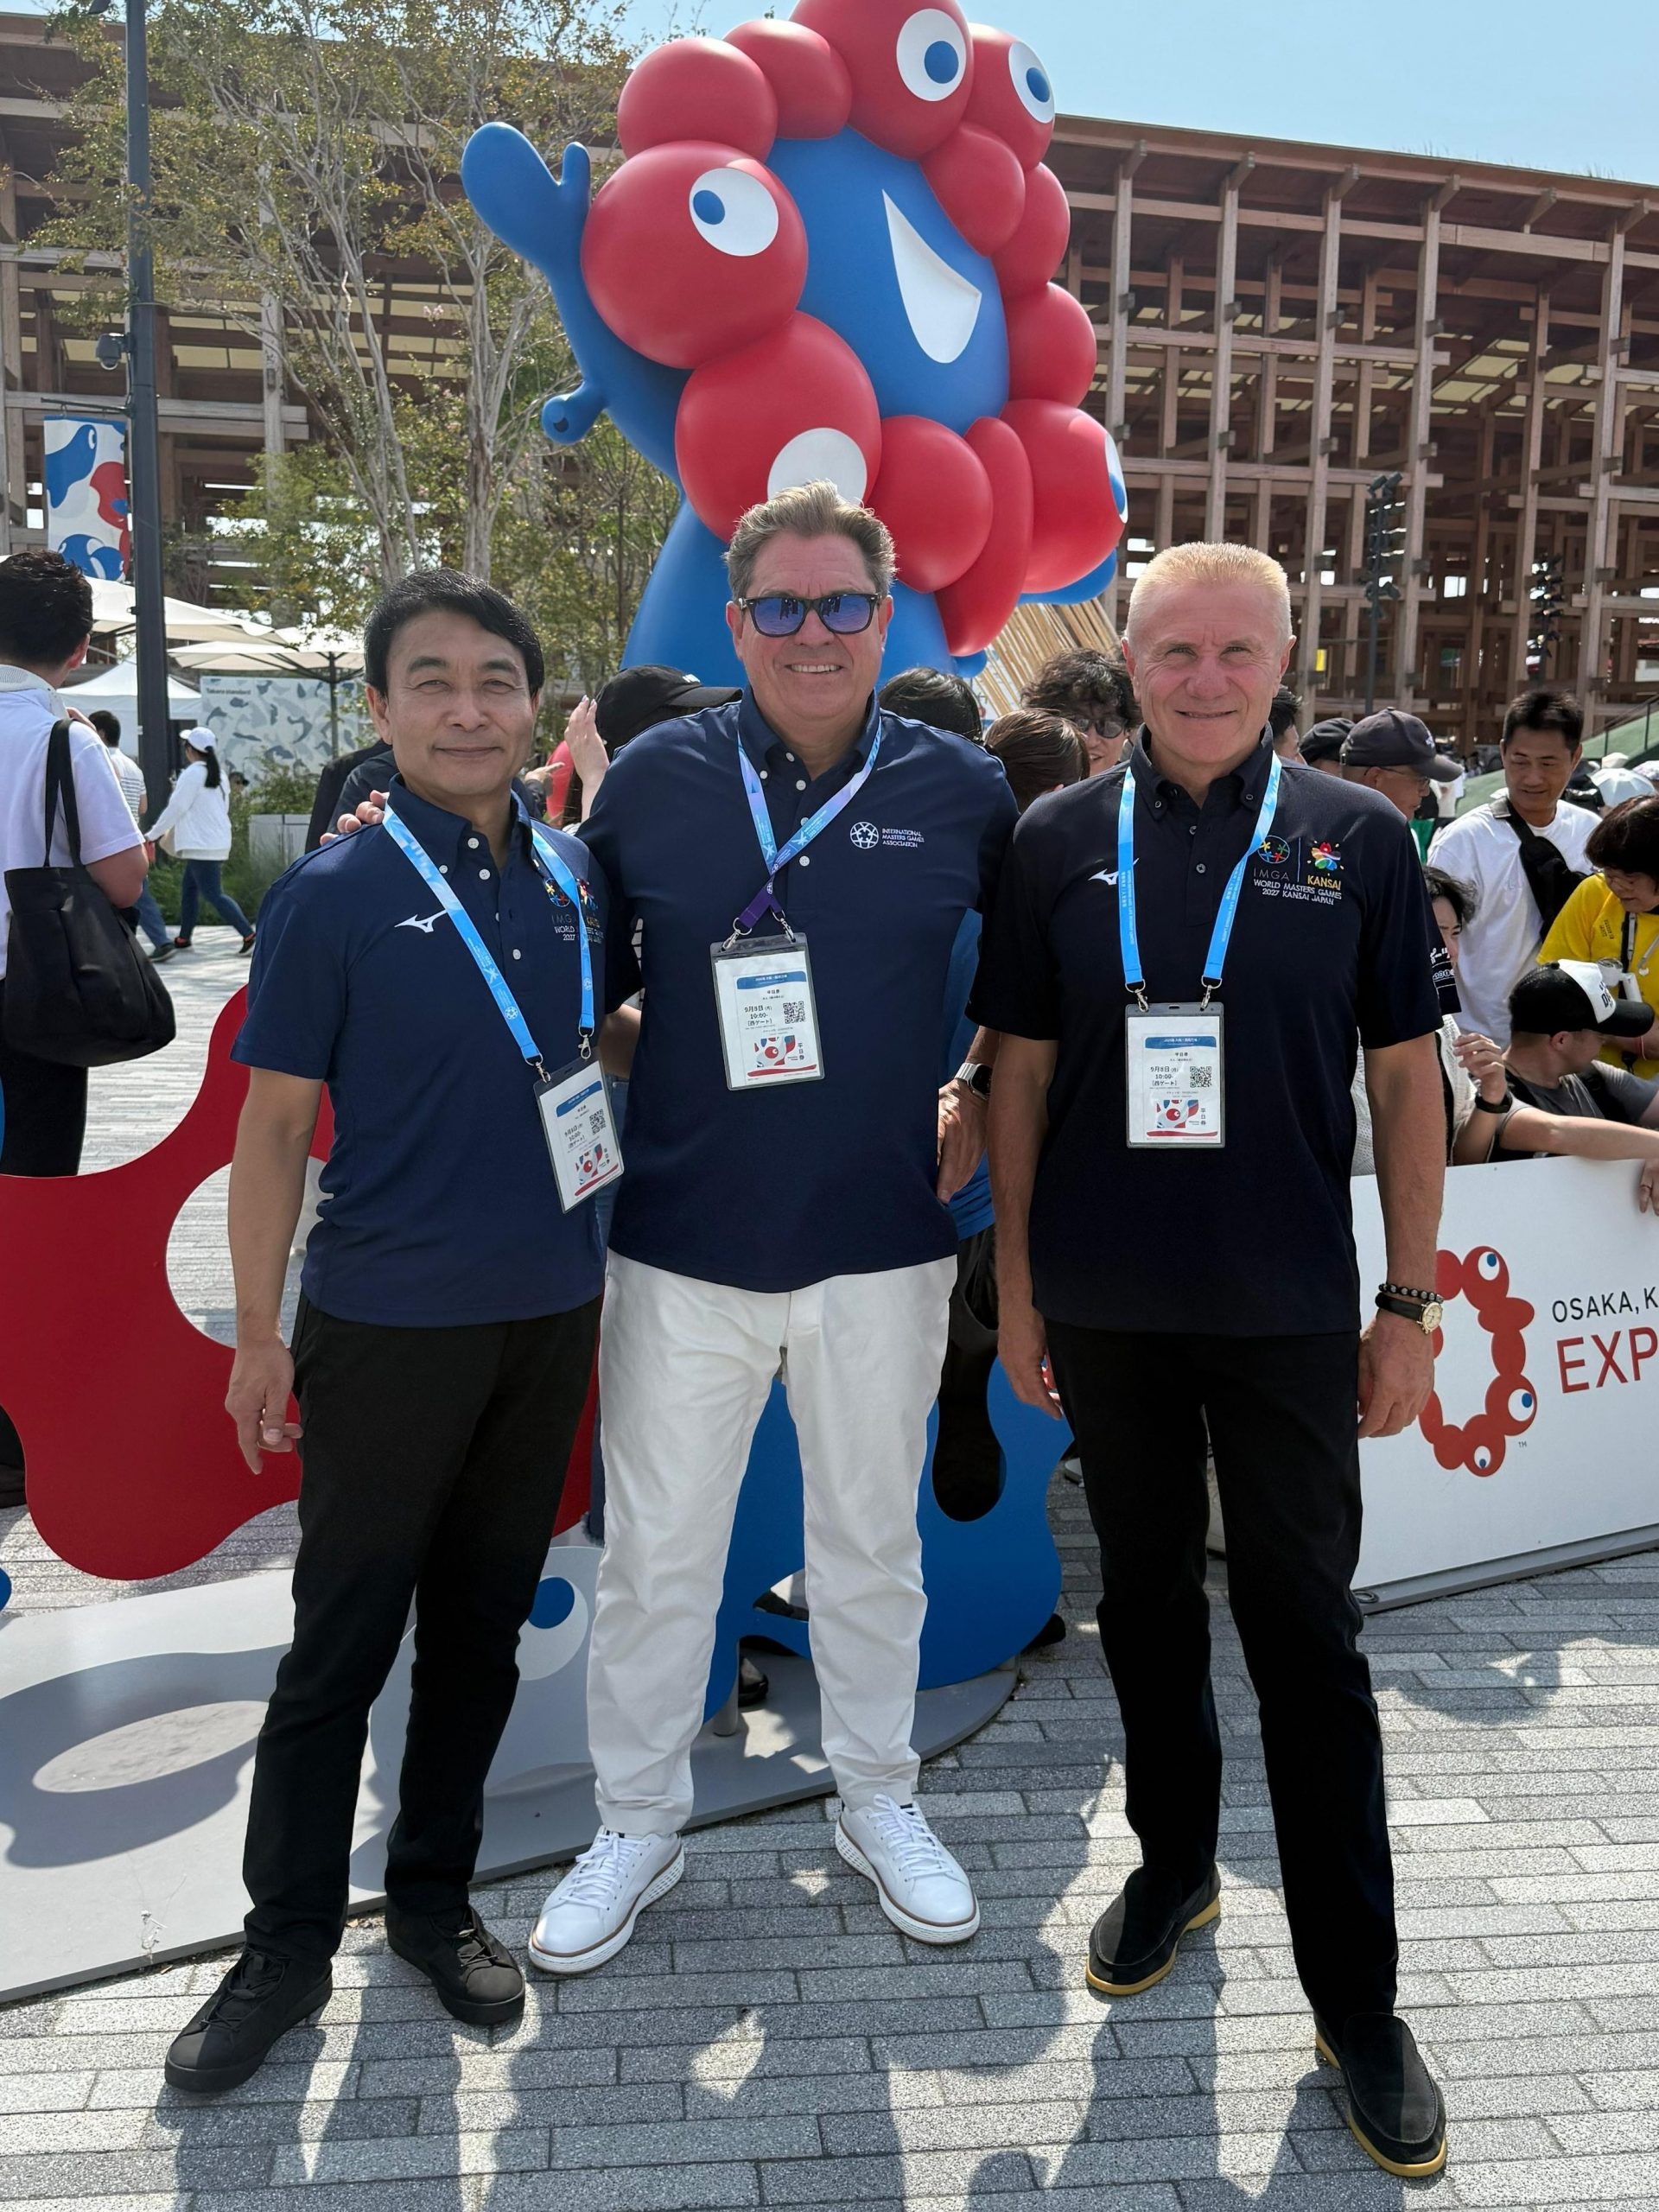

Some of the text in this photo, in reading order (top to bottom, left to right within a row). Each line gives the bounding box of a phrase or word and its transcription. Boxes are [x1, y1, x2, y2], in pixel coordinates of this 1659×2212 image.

[1254, 866, 1290, 881] IMGA
[1307, 874, 1343, 891] KANSAI
[1253, 878, 1343, 900] WORLD MASTERS GAMES
[1262, 887, 1335, 906] 2027 KANSAI JAPAN
[554, 925, 575, 934] WORLD
[1552, 1291, 1640, 1323] OSAKA,
[1556, 1326, 1659, 1394] EXP
